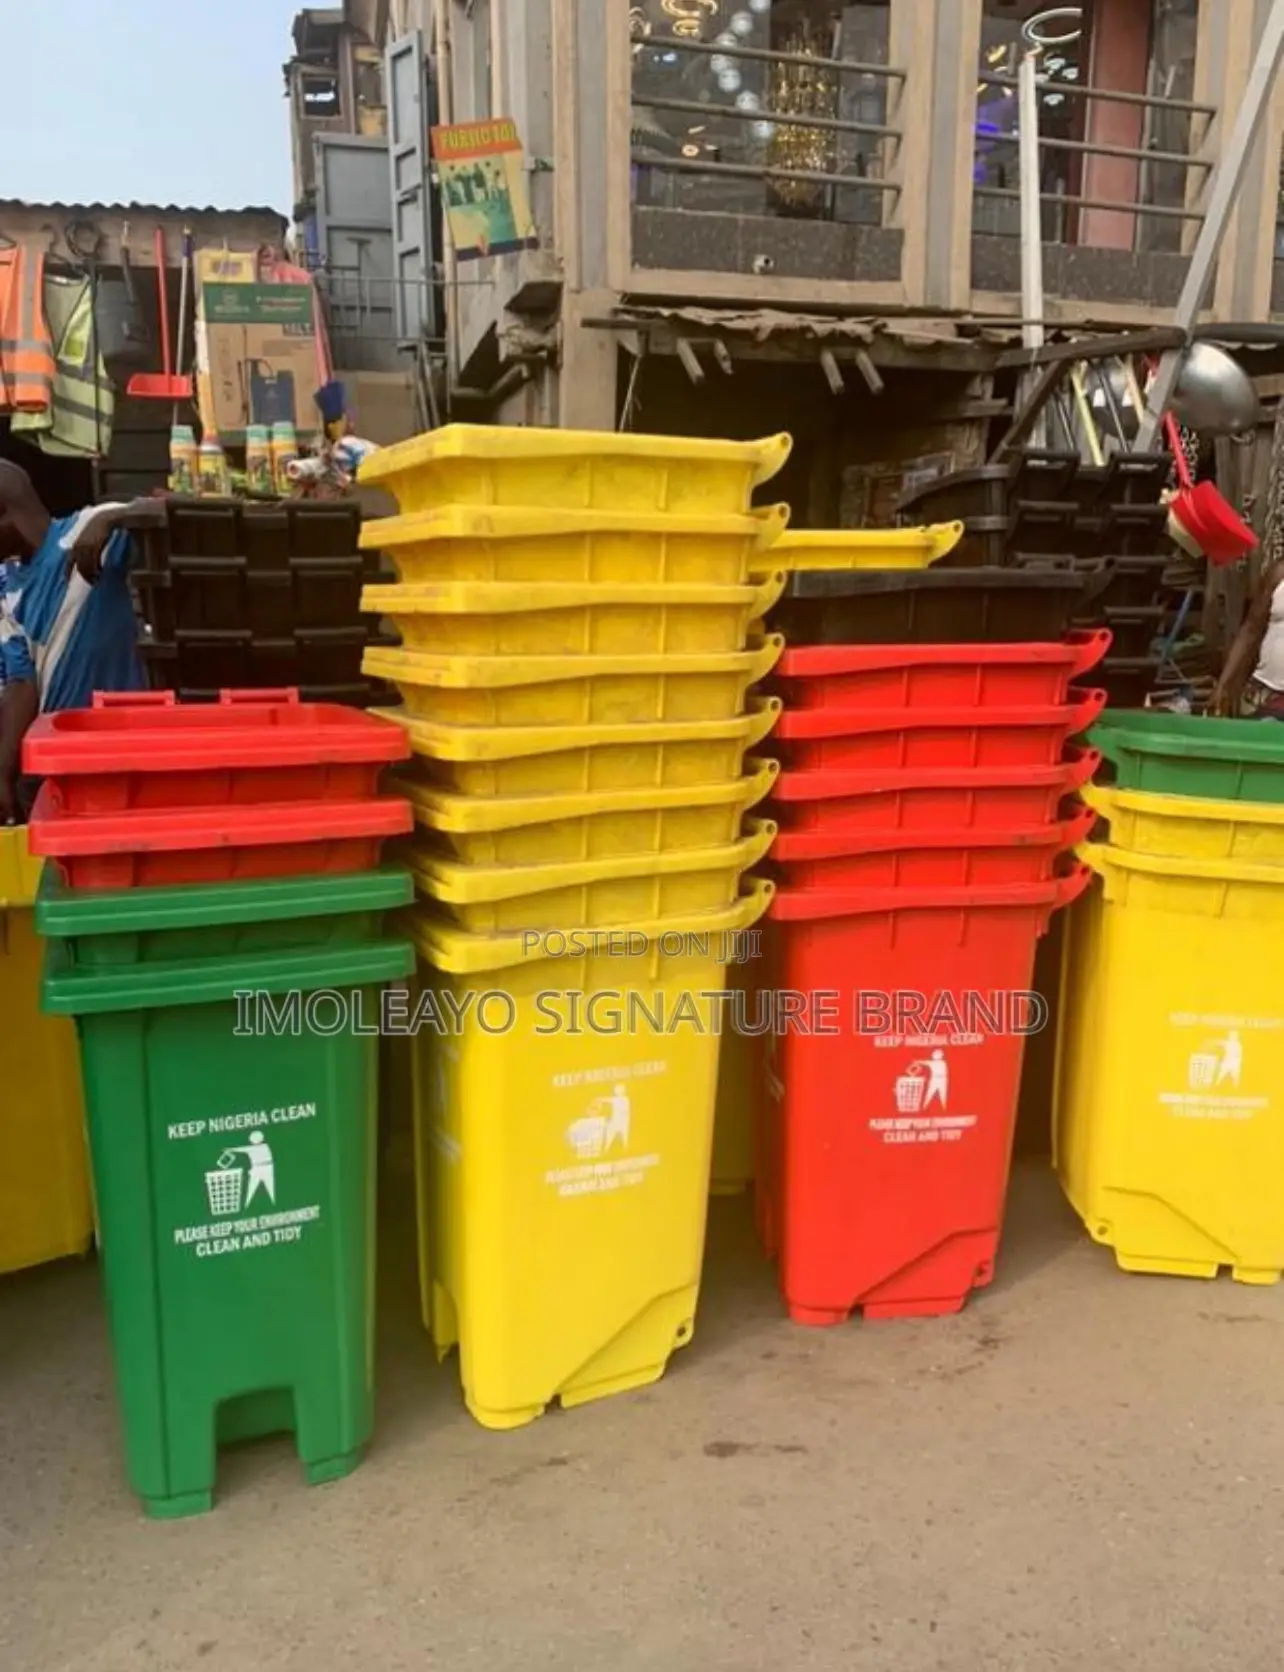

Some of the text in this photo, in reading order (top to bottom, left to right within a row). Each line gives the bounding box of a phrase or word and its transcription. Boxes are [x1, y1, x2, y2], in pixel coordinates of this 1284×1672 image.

[167, 1102, 317, 1140] KEEP NIGERIA CLEAN
[195, 1224, 302, 1258] CLEAN AND TIDY
